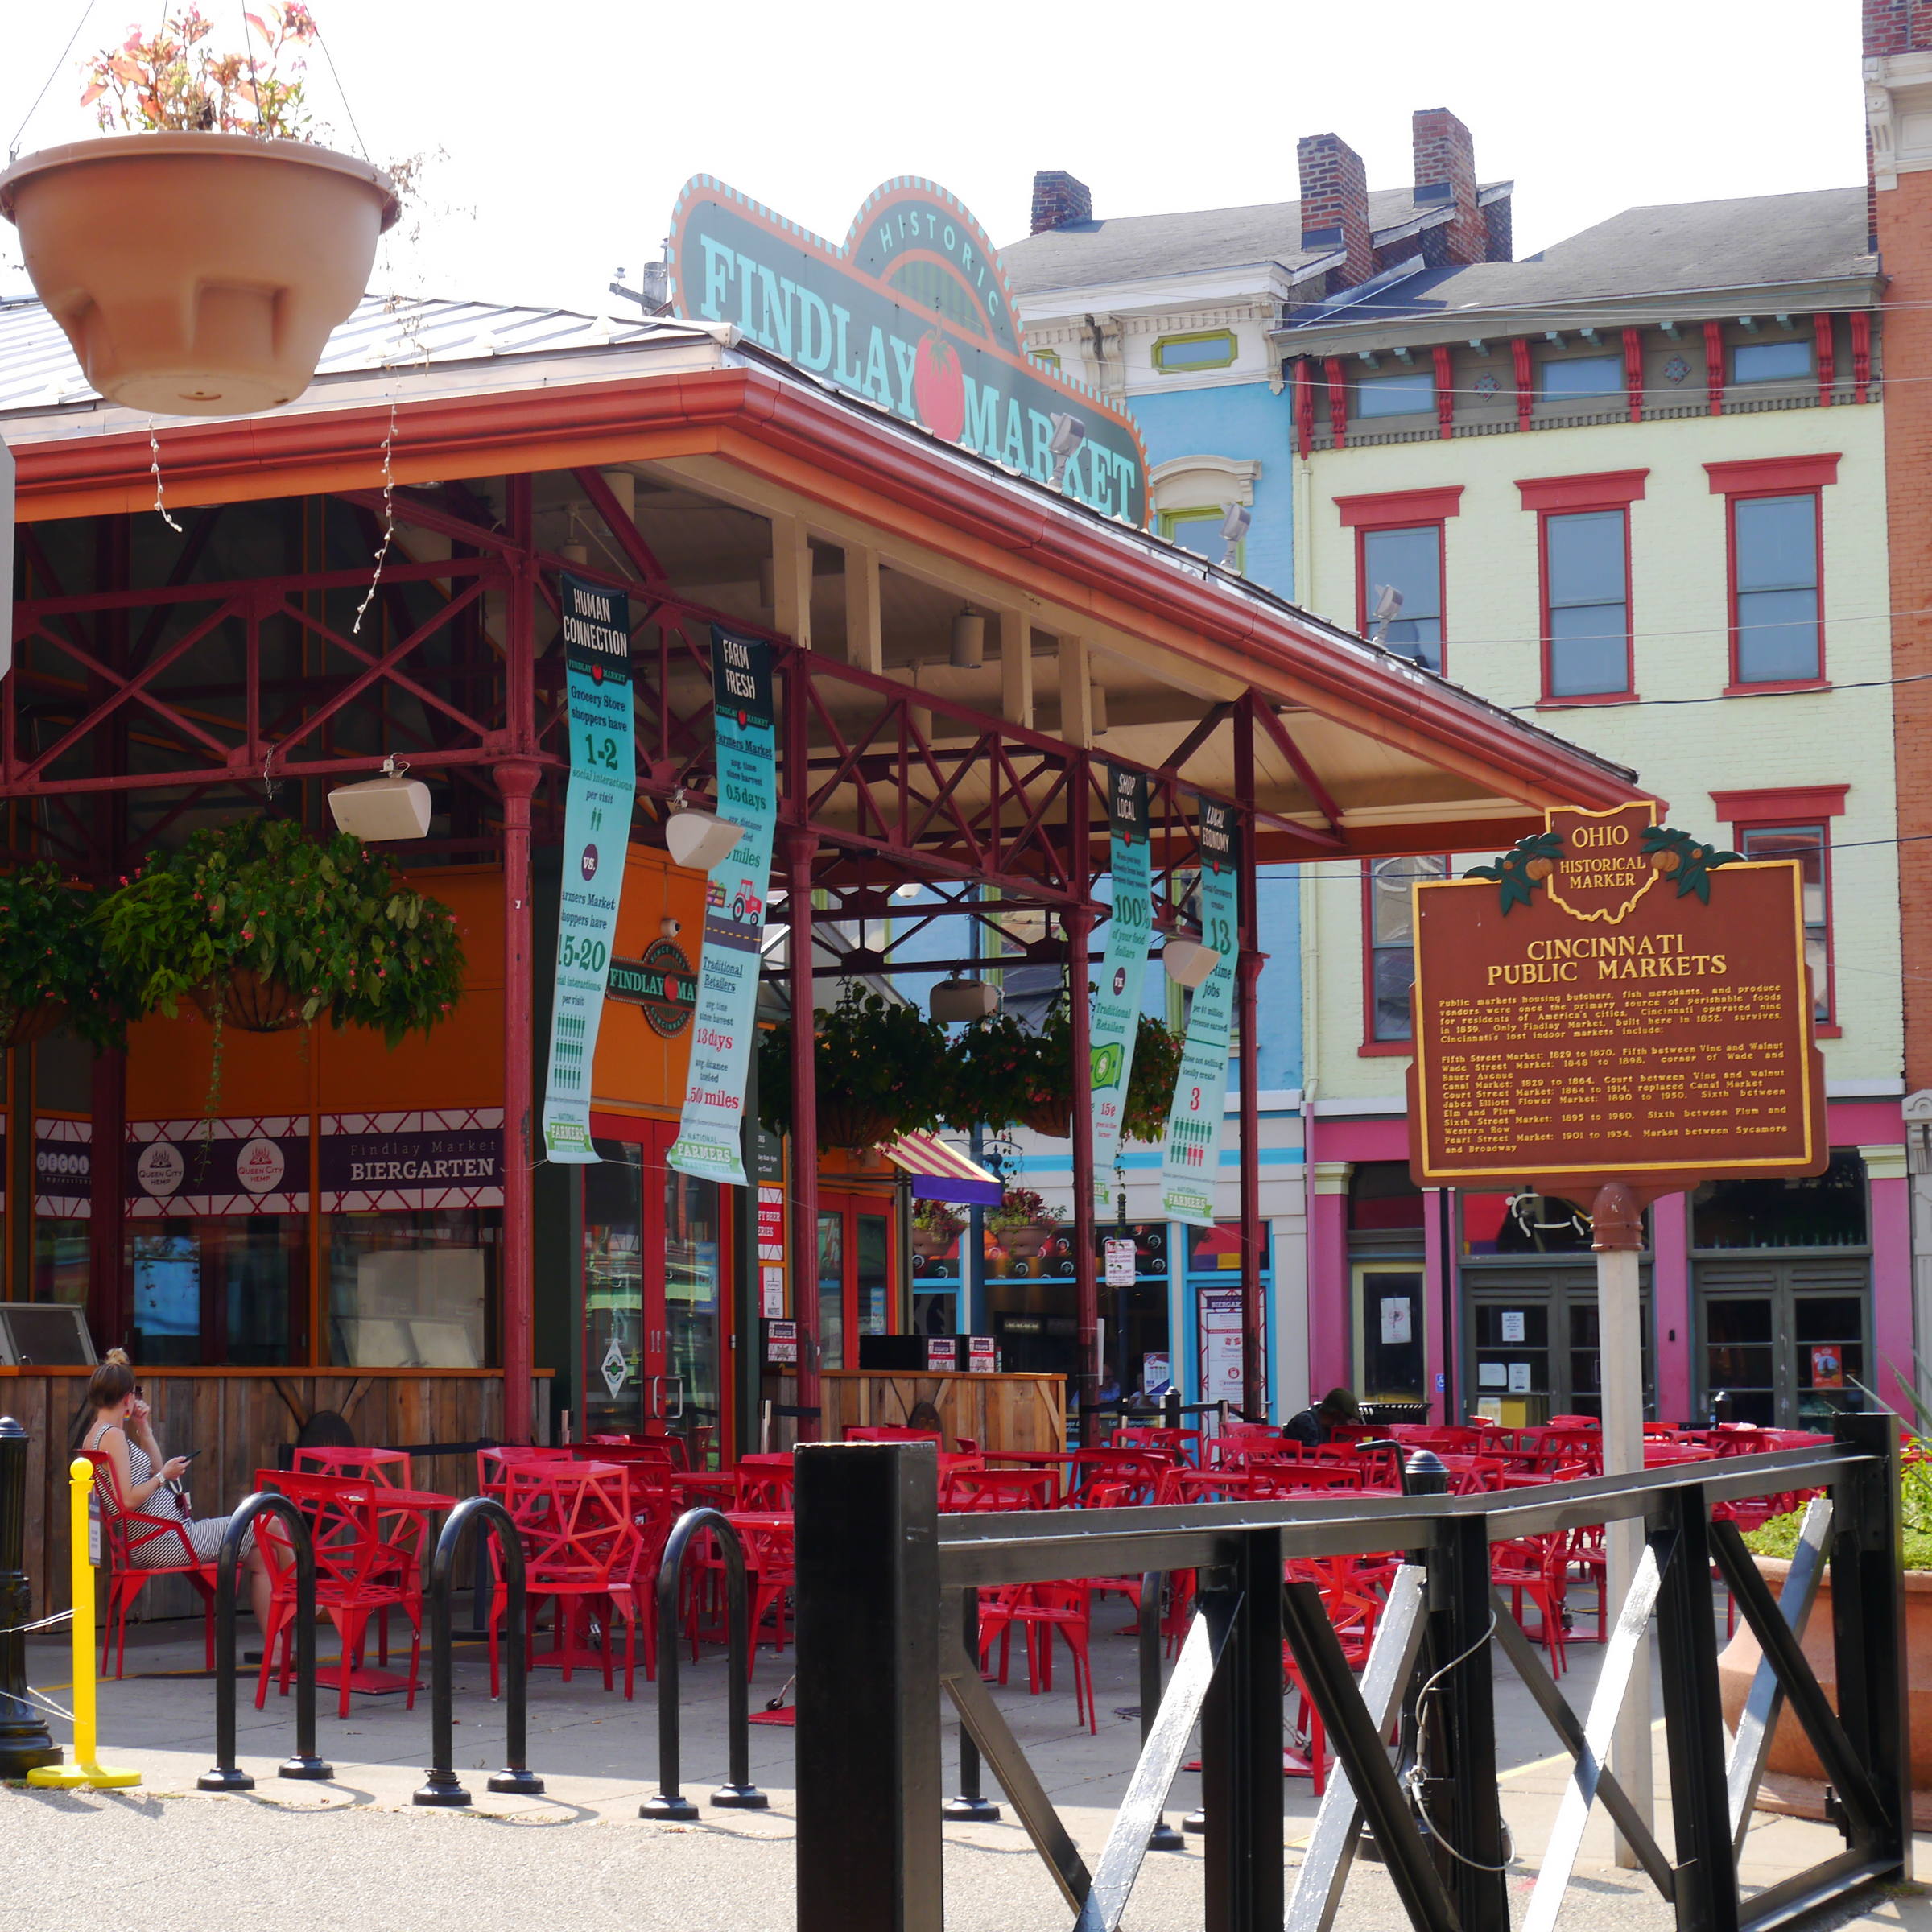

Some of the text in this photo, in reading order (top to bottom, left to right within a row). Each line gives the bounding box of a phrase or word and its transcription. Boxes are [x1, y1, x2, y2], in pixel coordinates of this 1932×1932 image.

[880, 213, 1000, 317] HISTORIC
[700, 233, 1135, 522] FINDLAY MARKET
[573, 588, 611, 624] HUMAN
[564, 615, 628, 658] CONNECTION
[722, 638, 750, 670] FARM
[726, 669, 755, 700] FRESH
[571, 685, 625, 712] Grocery Store
[572, 707, 627, 732] shoppers have
[585, 733, 618, 770] 1-2
[745, 740, 772, 758] Market
[1117, 773, 1137, 795] SHOP
[1117, 798, 1137, 821] LOCAL
[1572, 824, 1629, 849] OHIO
[732, 848, 761, 868] miles
[1559, 857, 1646, 874] HISTORICAL
[1570, 873, 1637, 890] MARKER
[587, 894, 616, 910] Market
[1527, 934, 1684, 961] CINCINNATI
[703, 956, 743, 976] Traditional
[1487, 955, 1728, 987] PUBLIC MARKETS
[609, 968, 664, 996] FINDLAY
[1439, 999, 1470, 1007] Public
[1477, 997, 1517, 1005] markets
[1521, 995, 1561, 1006] housing
[1738, 985, 1781, 996] produce
[1574, 1002, 1615, 1013] primary
[1625, 1000, 1660, 1009] source
[1688, 995, 1743, 1007] perishable
[1752, 993, 1781, 1001] foods
[1462, 1014, 1509, 1025] residents
[1641, 1005, 1693, 1017] Cincinnati
[1703, 1004, 1750, 1016] operated
[697, 1028, 708, 1044] 13
[1492, 1024, 1517, 1034] Only
[1523, 1022, 1560, 1034] Findlay
[1574, 1029, 1613, 1037] markets
[1623, 1047, 1647, 1055] Fifth
[704, 1089, 739, 1109] miles
[1191, 1087, 1200, 1111] 3
[1701, 1090, 1729, 1098] Sixth
[1740, 1087, 1785, 1096] between
[1445, 1125, 1484, 1134] Western
[351, 1140, 497, 1158] Findlay Market
[677, 1142, 731, 1162] FARMERS
[1469, 1145, 1517, 1153] Broadway
[138, 1169, 182, 1178] QUEEN CITY
[250, 1175, 271, 1183] HEMP
[350, 1158, 495, 1181] BIERGARTEN
